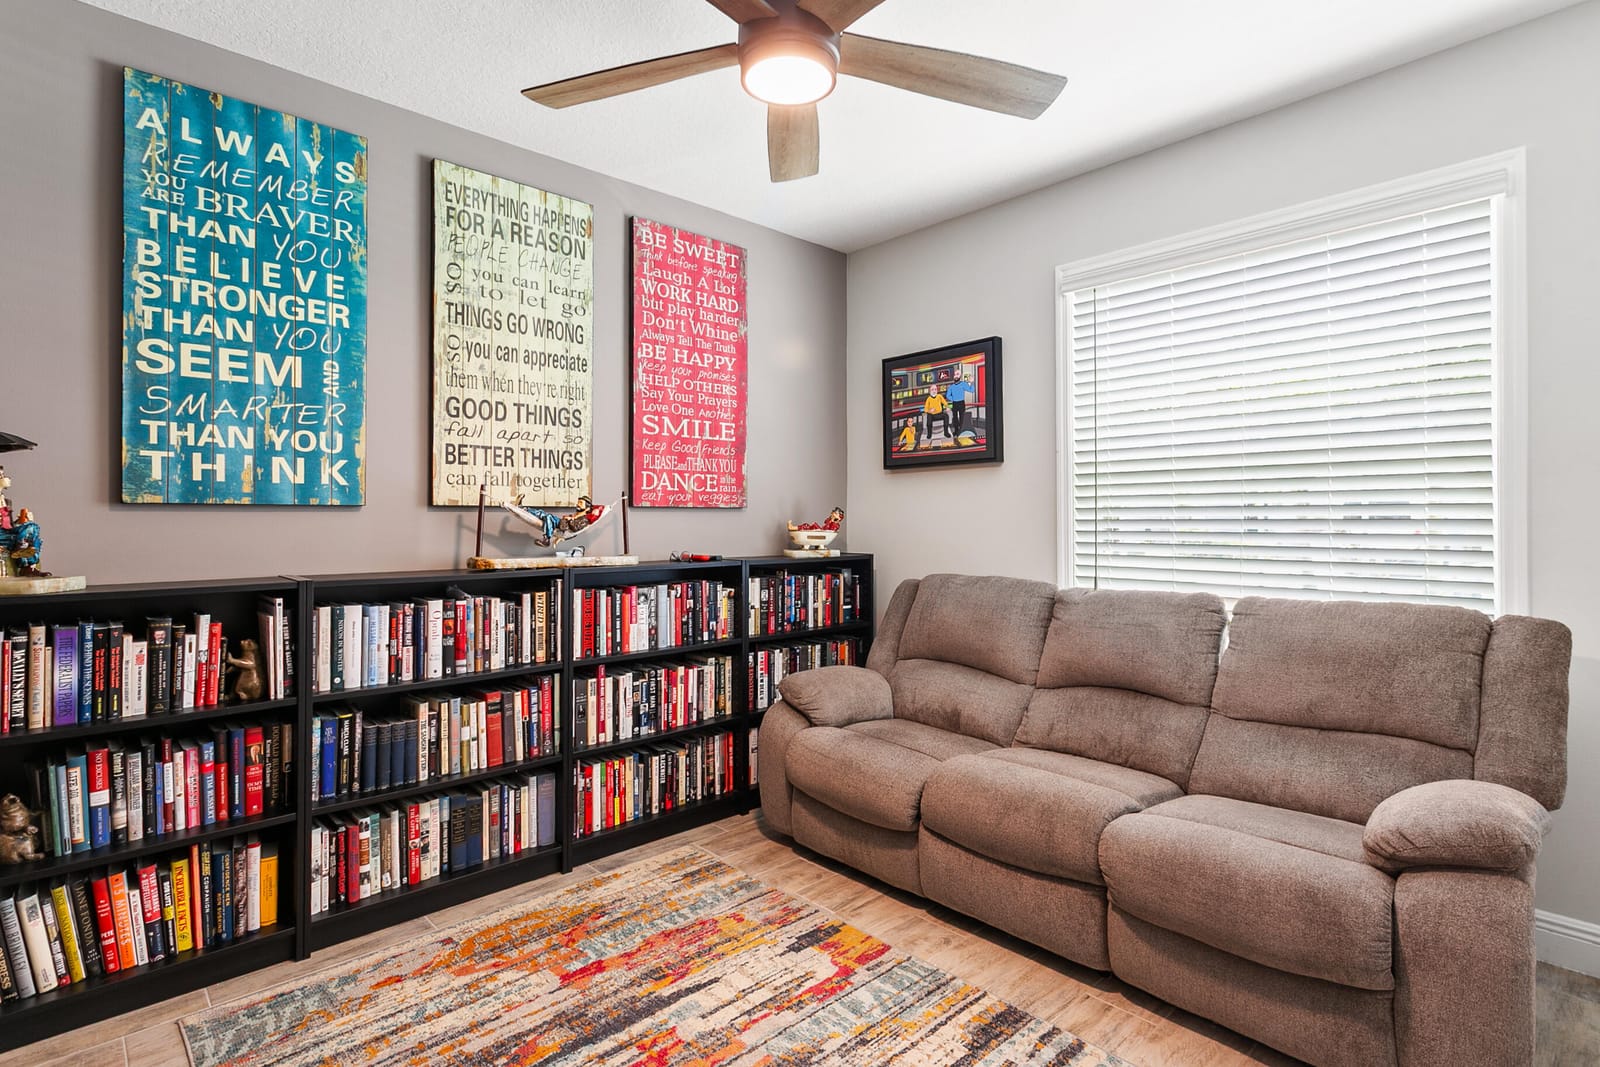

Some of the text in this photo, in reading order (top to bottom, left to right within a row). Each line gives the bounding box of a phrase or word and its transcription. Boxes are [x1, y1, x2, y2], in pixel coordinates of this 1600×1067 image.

[135, 107, 356, 184] ALWAYS
[140, 168, 187, 190] YOU
[141, 142, 354, 213] REMEMBER
[140, 186, 186, 207] ARE
[445, 181, 586, 238] EVERYTHING HAPPENS
[194, 185, 356, 243] BRAVER
[140, 206, 342, 269] THAN YOU
[446, 206, 586, 260] FOR A REASON
[641, 229, 739, 268] BE SWEET
[137, 238, 345, 300] BELIEVE
[448, 233, 583, 280] PEOPLE CHANGE
[667, 255, 698, 271] before
[703, 265, 738, 284] speaking
[472, 268, 504, 283] you
[512, 276, 539, 291] can
[549, 279, 586, 300] learn
[641, 278, 739, 313] WORK HARD
[642, 261, 736, 296] Laugh A Lot
[135, 271, 350, 329] STRONGER
[480, 285, 587, 319] to let go
[641, 295, 739, 327] but play harder
[139, 305, 342, 354] THAN YOU
[444, 301, 585, 345] THINGS GO WRONG
[642, 310, 738, 342] Don't Whine
[465, 341, 491, 363] you
[496, 345, 519, 364] can
[523, 347, 588, 373] appreciate
[641, 328, 736, 354] Always Tell The Truth
[641, 342, 737, 372] BE HAPPY
[135, 338, 303, 389] SEEM
[323, 360, 340, 399] AND
[671, 367, 692, 379] your
[698, 370, 736, 382] promises
[445, 365, 586, 406] them when they're right
[641, 373, 737, 396] HELP OTHERS
[641, 386, 738, 408] Say Your Prayers
[139, 385, 346, 427] SMARTER
[445, 396, 582, 428] GOOD THINGS
[642, 400, 668, 413] Love
[671, 403, 695, 416] One
[140, 419, 344, 455] THAN YOU
[444, 421, 584, 445] fall apart so
[642, 414, 736, 442] SMILE
[139, 450, 349, 487] THINK
[445, 443, 583, 471] BETTER THINGS
[643, 454, 678, 470] PLEASE
[687, 457, 718, 472] THANK
[719, 459, 736, 473] YOU
[446, 471, 583, 492] can fall together
[641, 471, 718, 492] DANCE
